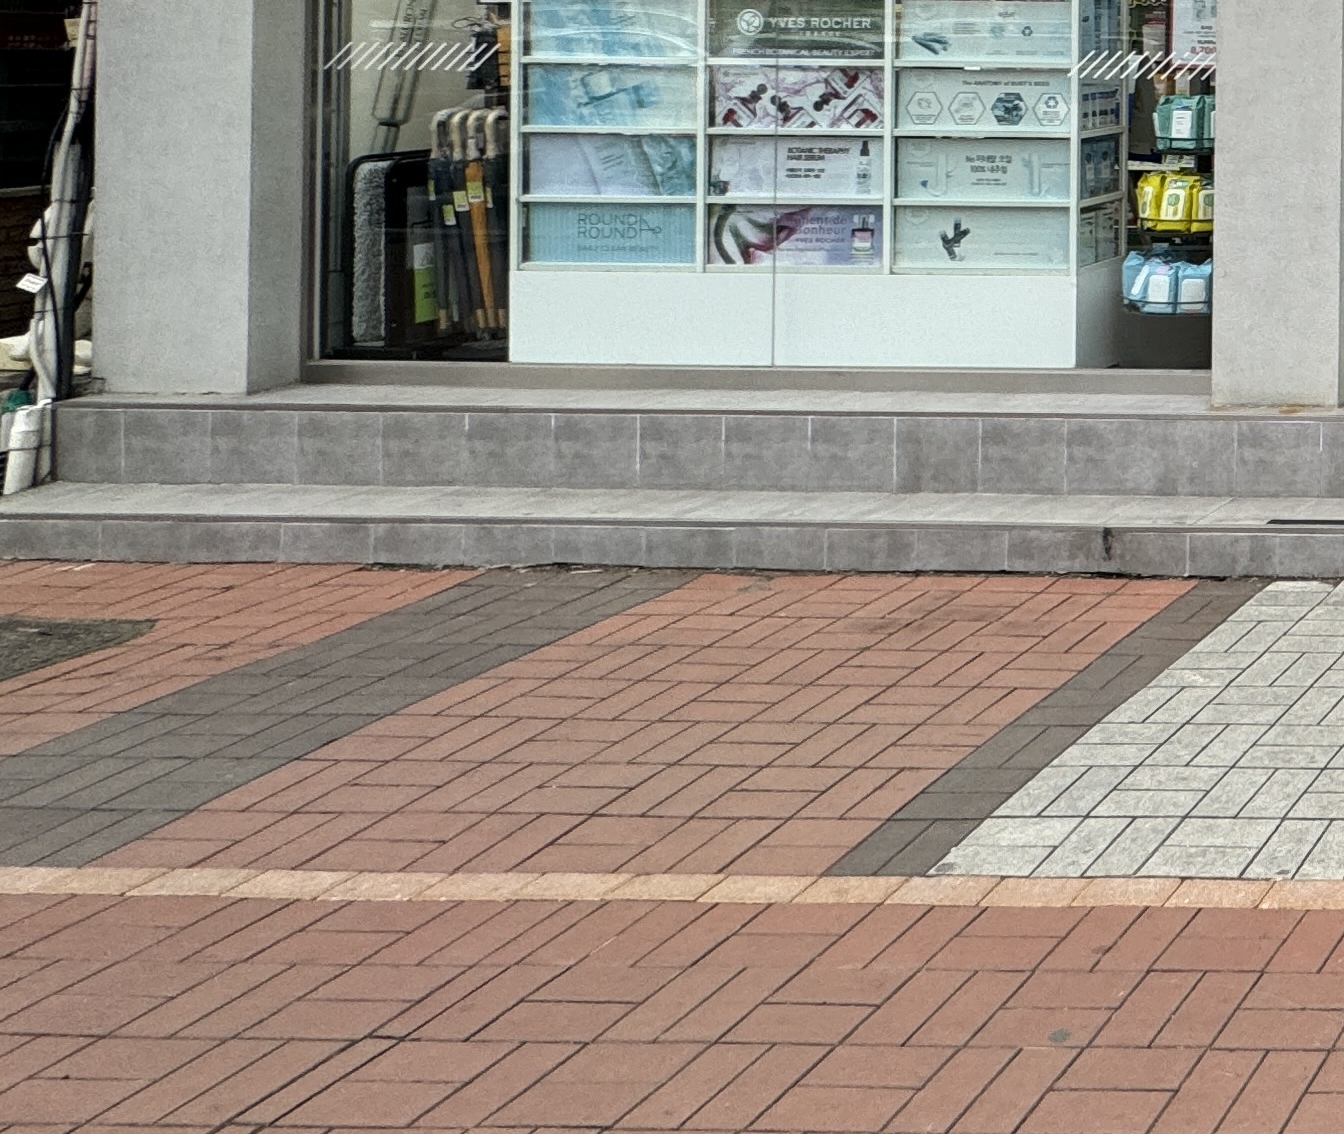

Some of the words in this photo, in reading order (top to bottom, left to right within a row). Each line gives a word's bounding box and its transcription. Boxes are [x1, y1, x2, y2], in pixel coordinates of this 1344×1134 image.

[768, 17, 805, 29] YVES
[810, 17, 871, 29] ROCHER
[577, 212, 638, 226] ROUND
[577, 226, 638, 239] ROUND
